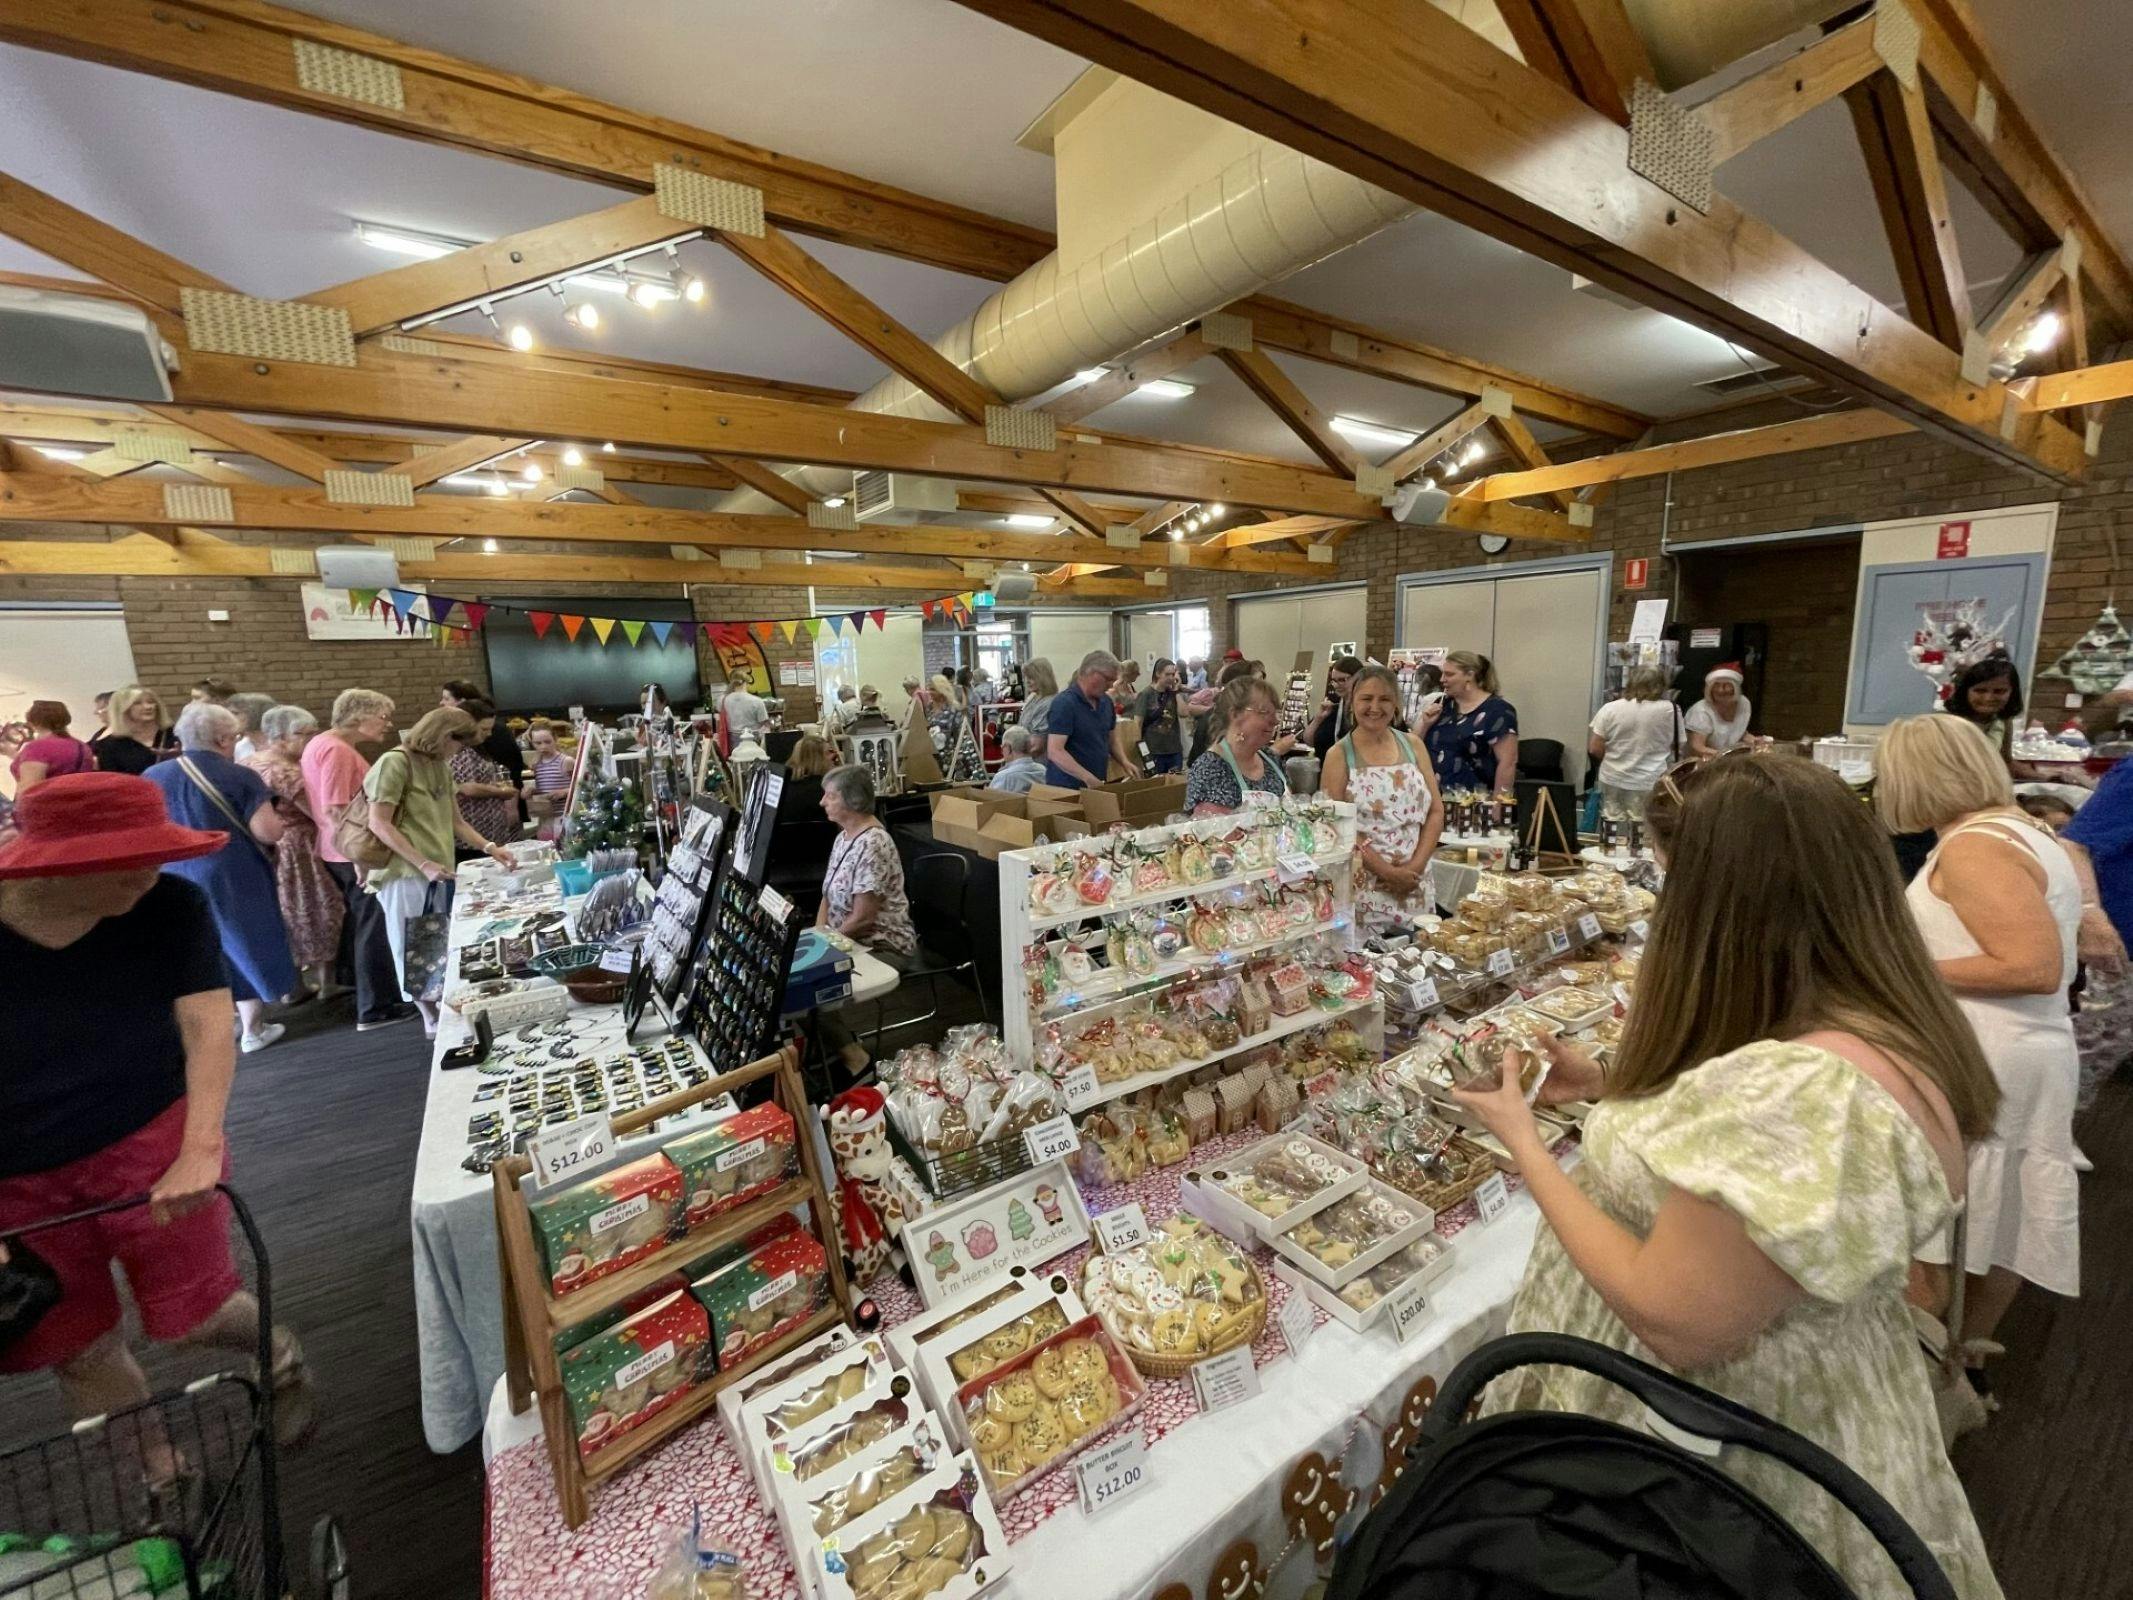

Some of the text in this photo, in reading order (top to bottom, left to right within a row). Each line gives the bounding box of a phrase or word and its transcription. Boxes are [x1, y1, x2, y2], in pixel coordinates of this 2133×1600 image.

[1068, 1081, 1091, 1099] $7.50
[550, 1141, 604, 1174] $12.00
[1044, 1139, 1071, 1158] $4.00
[605, 1202, 632, 1217] MERRY
[1112, 1229, 1140, 1248] $1.50
[939, 1224, 1074, 1297] I'm Here for the Cookies
[1398, 1295, 1426, 1326] $20.00
[1085, 1440, 1134, 1470] BUTTER BISCUIT
[1104, 1460, 1119, 1473] BOX
[1095, 1466, 1142, 1503] $12.00
